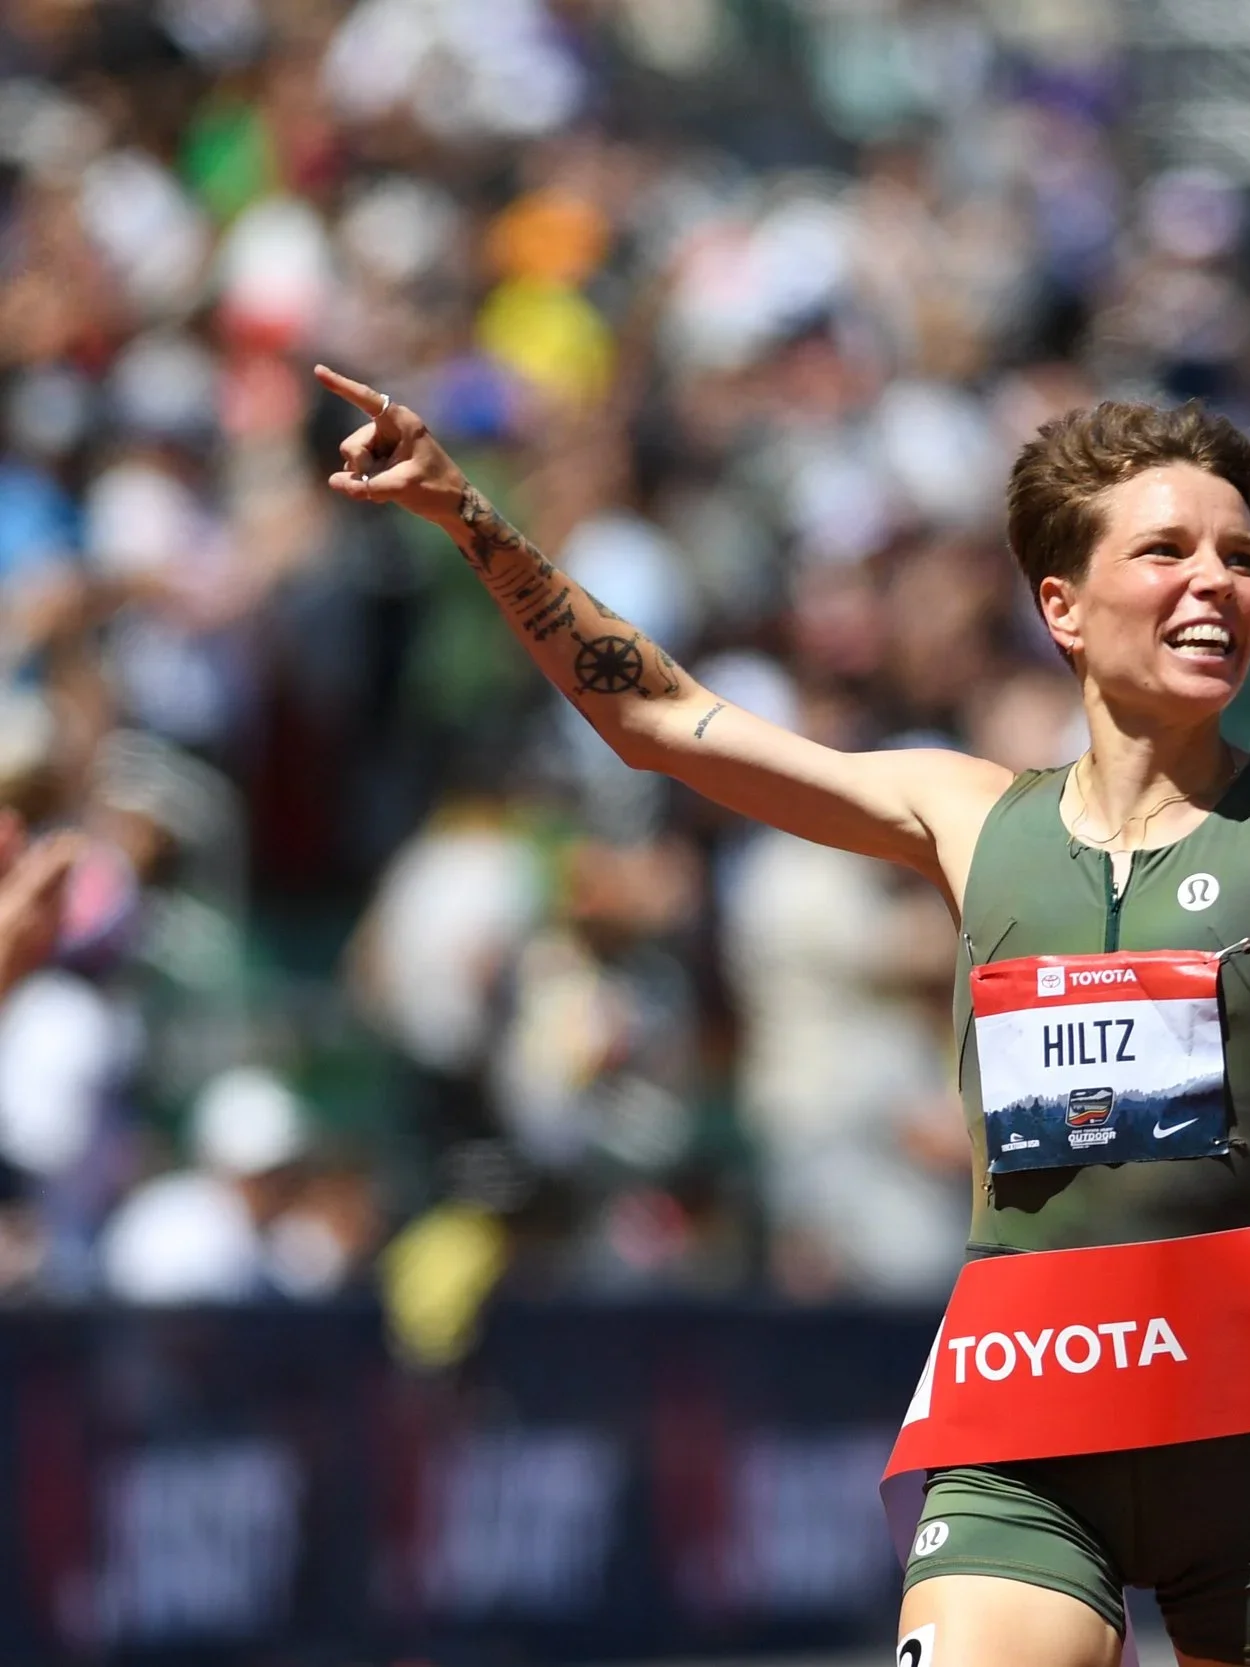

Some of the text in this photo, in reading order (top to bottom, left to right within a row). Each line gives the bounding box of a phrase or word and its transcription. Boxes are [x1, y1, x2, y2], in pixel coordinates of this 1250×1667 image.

[1069, 968, 1137, 987] TOYOTA
[1043, 1018, 1136, 1068] HILTZ
[1067, 1131, 1117, 1142] OUTDOOR
[948, 1317, 1188, 1383] TOYOTA
